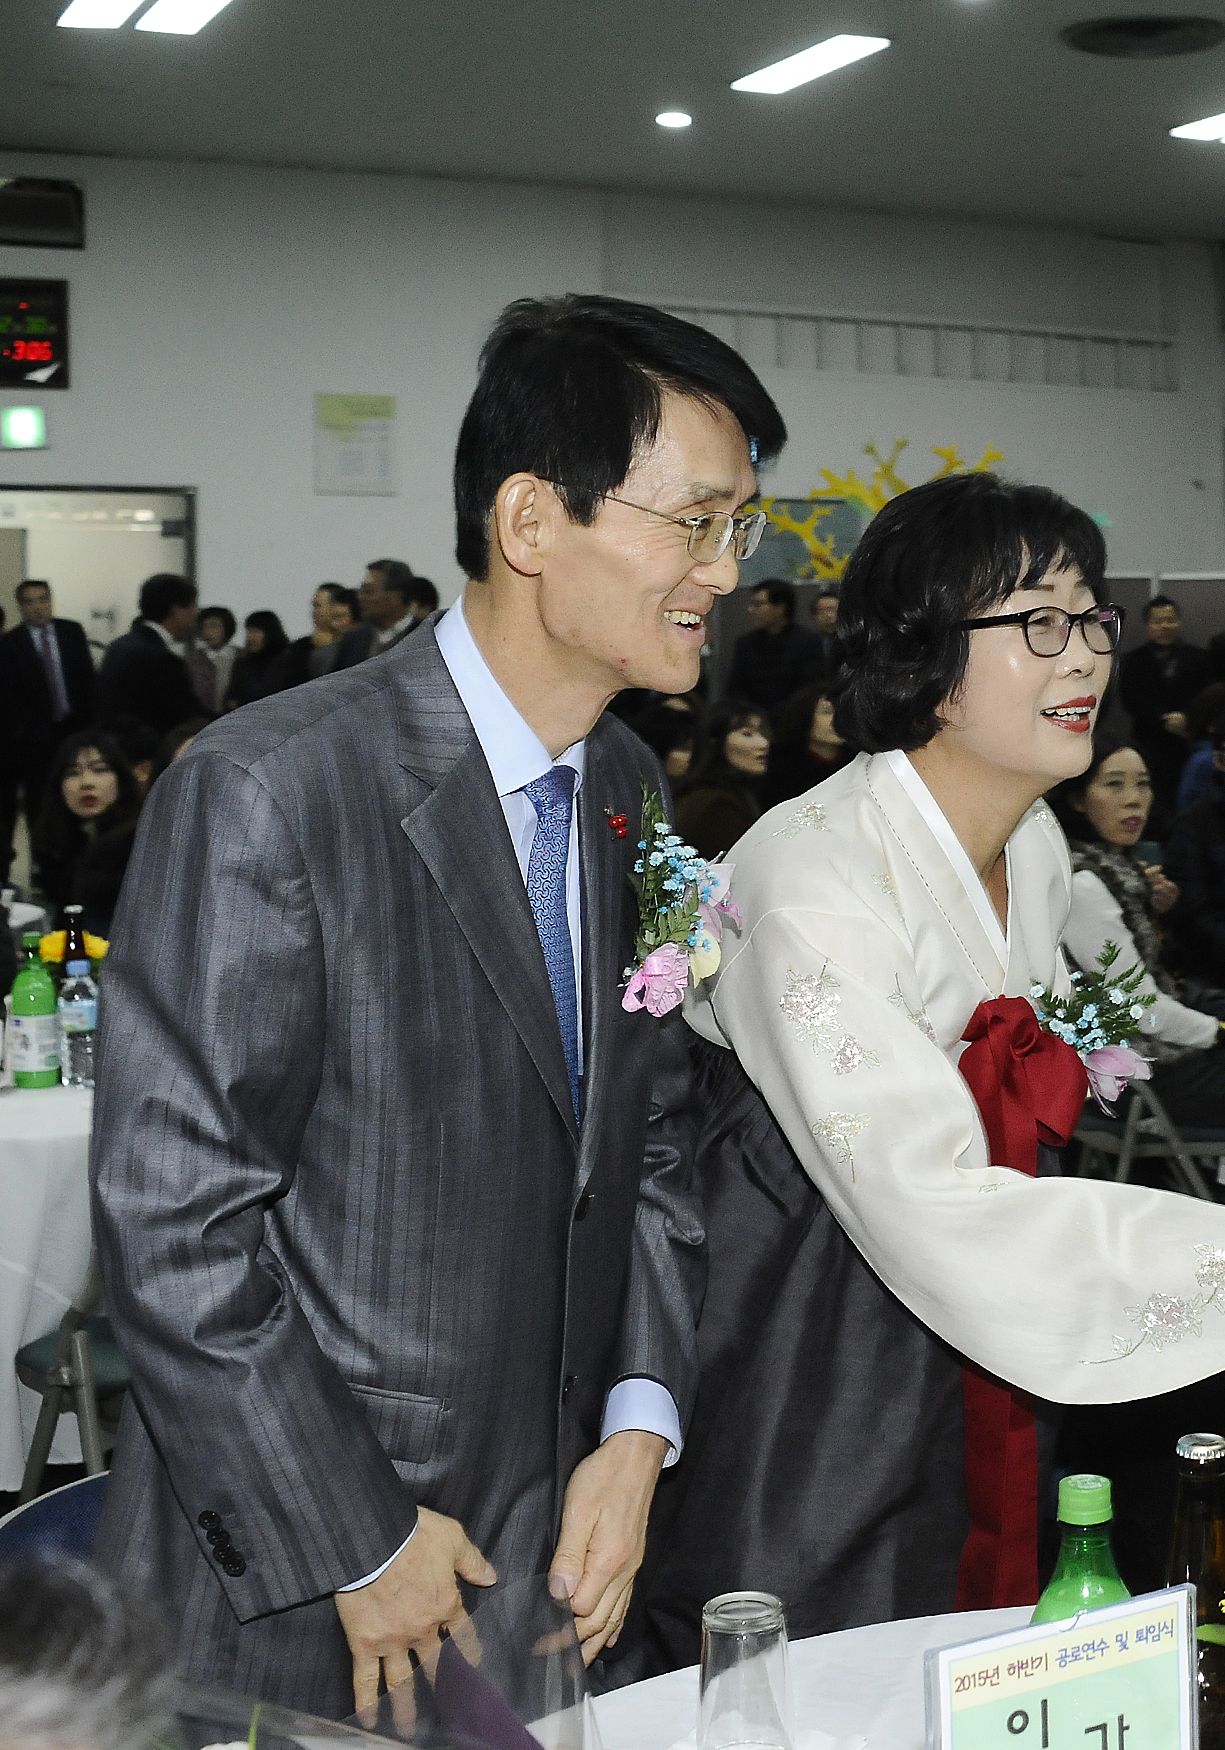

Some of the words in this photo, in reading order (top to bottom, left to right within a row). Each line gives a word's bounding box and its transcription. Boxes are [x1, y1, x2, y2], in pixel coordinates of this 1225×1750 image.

[954, 1665, 1000, 1693] 2015년
[1006, 1652, 1049, 1679] 하반기
[1055, 1639, 1110, 1668] 공로연수
[1115, 1631, 1129, 1652] 및
[1134, 1618, 1175, 1644] 퇴임식
[1006, 1698, 1049, 1749] 이
